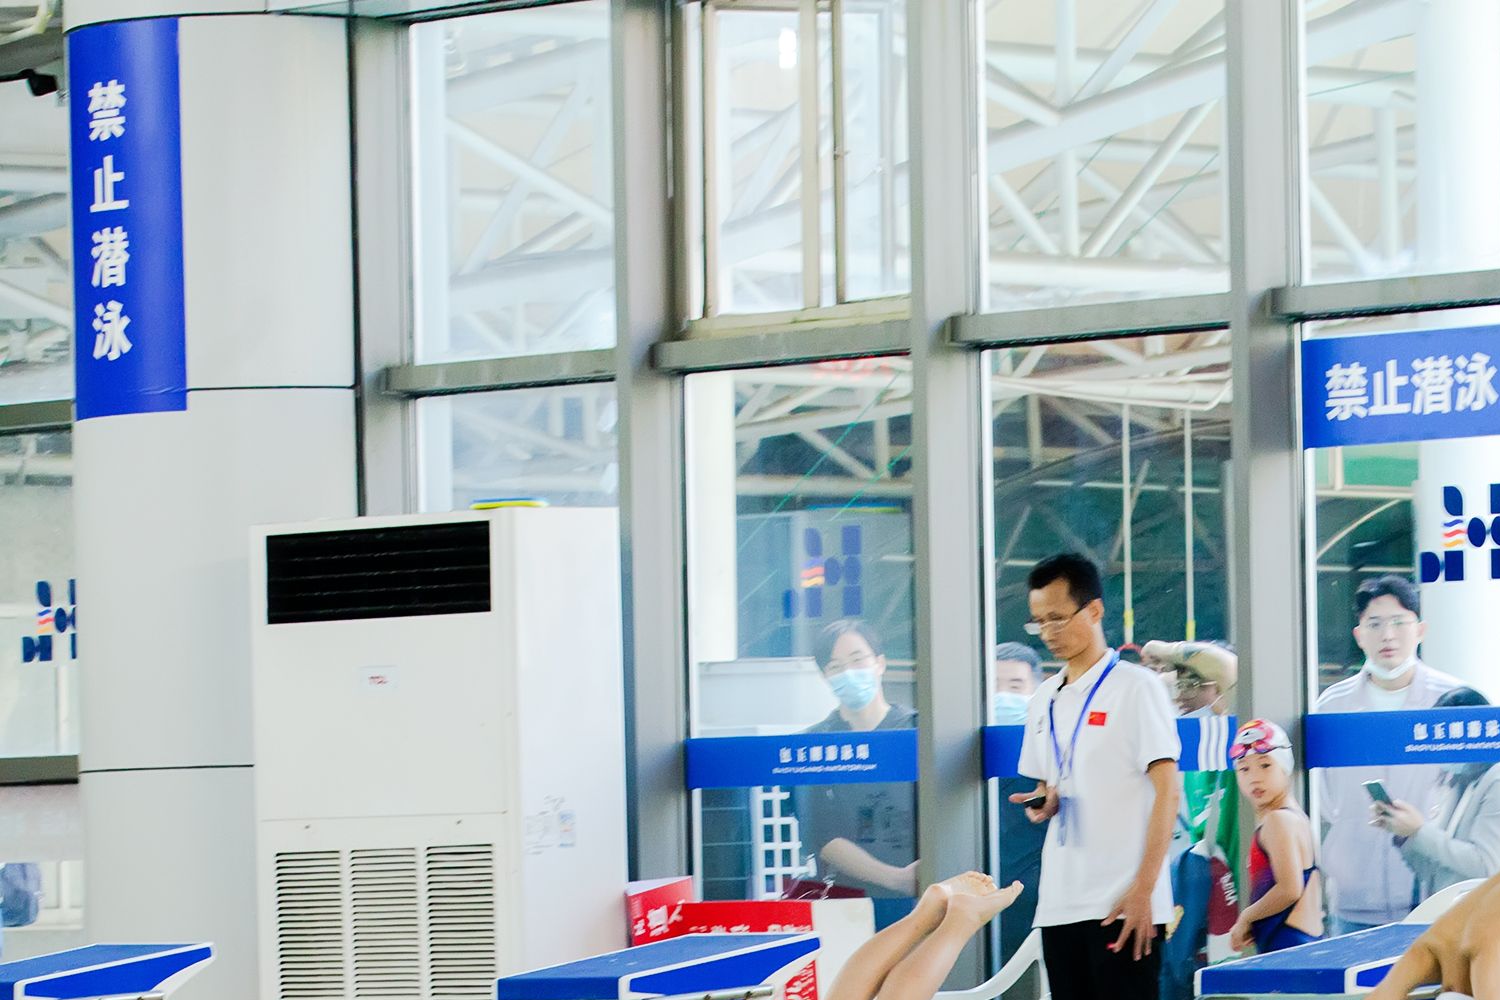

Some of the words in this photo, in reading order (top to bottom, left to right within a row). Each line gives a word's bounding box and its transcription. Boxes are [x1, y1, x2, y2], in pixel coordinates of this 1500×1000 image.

[88, 79, 133, 361] 禁止潜泳
[1325, 352, 1499, 421] 禁止潜泳
